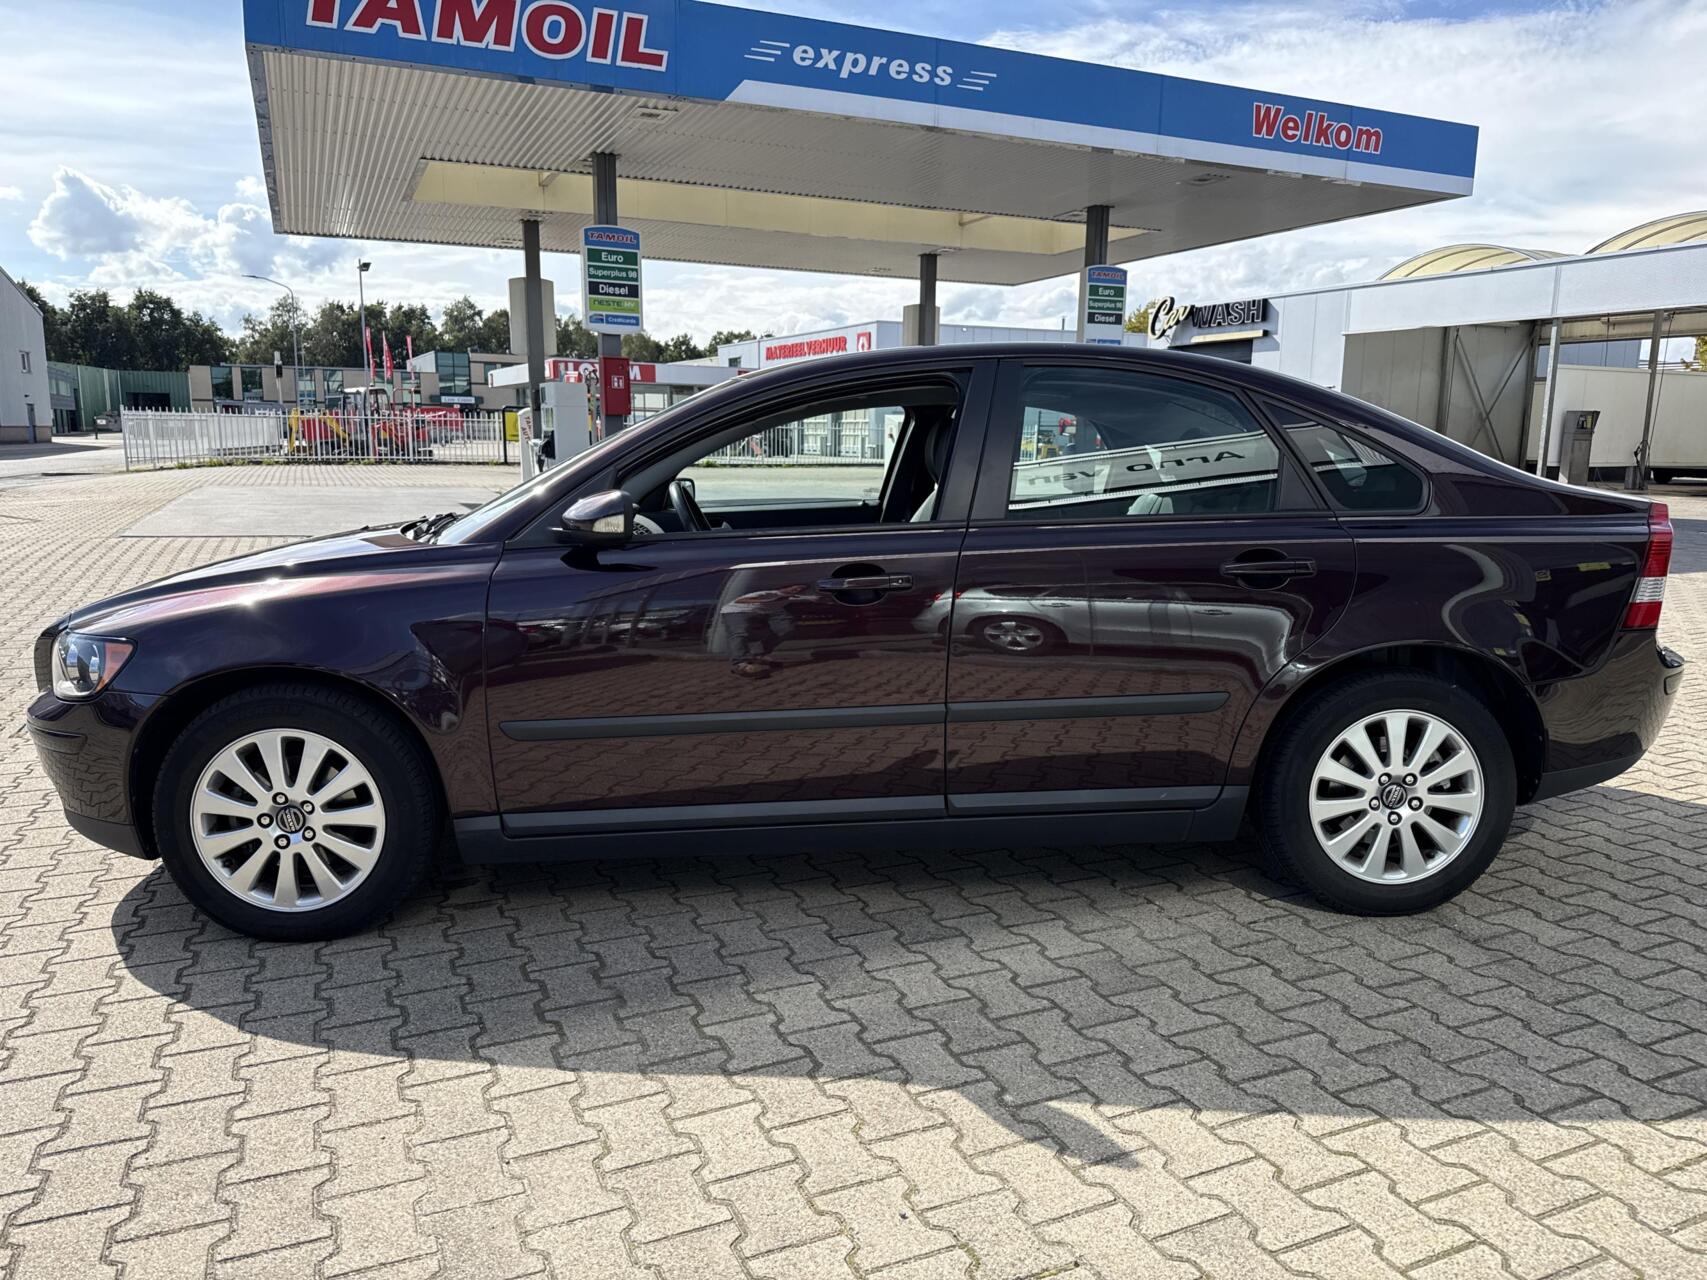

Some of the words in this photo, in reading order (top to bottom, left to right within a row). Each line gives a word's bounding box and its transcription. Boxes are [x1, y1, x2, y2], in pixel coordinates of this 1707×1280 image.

[792, 44, 954, 88] express
[1252, 101, 1384, 155] Welkom
[588, 231, 636, 244] TAMOIL
[601, 252, 624, 263] Euro
[589, 267, 627, 278] Superplus
[1090, 270, 1125, 281] TAMOIL
[599, 284, 629, 295] Diesel
[1098, 287, 1115, 296] Euro
[1094, 314, 1116, 323] Diesel
[1148, 296, 1193, 340] Car
[1191, 299, 1266, 329] WASH
